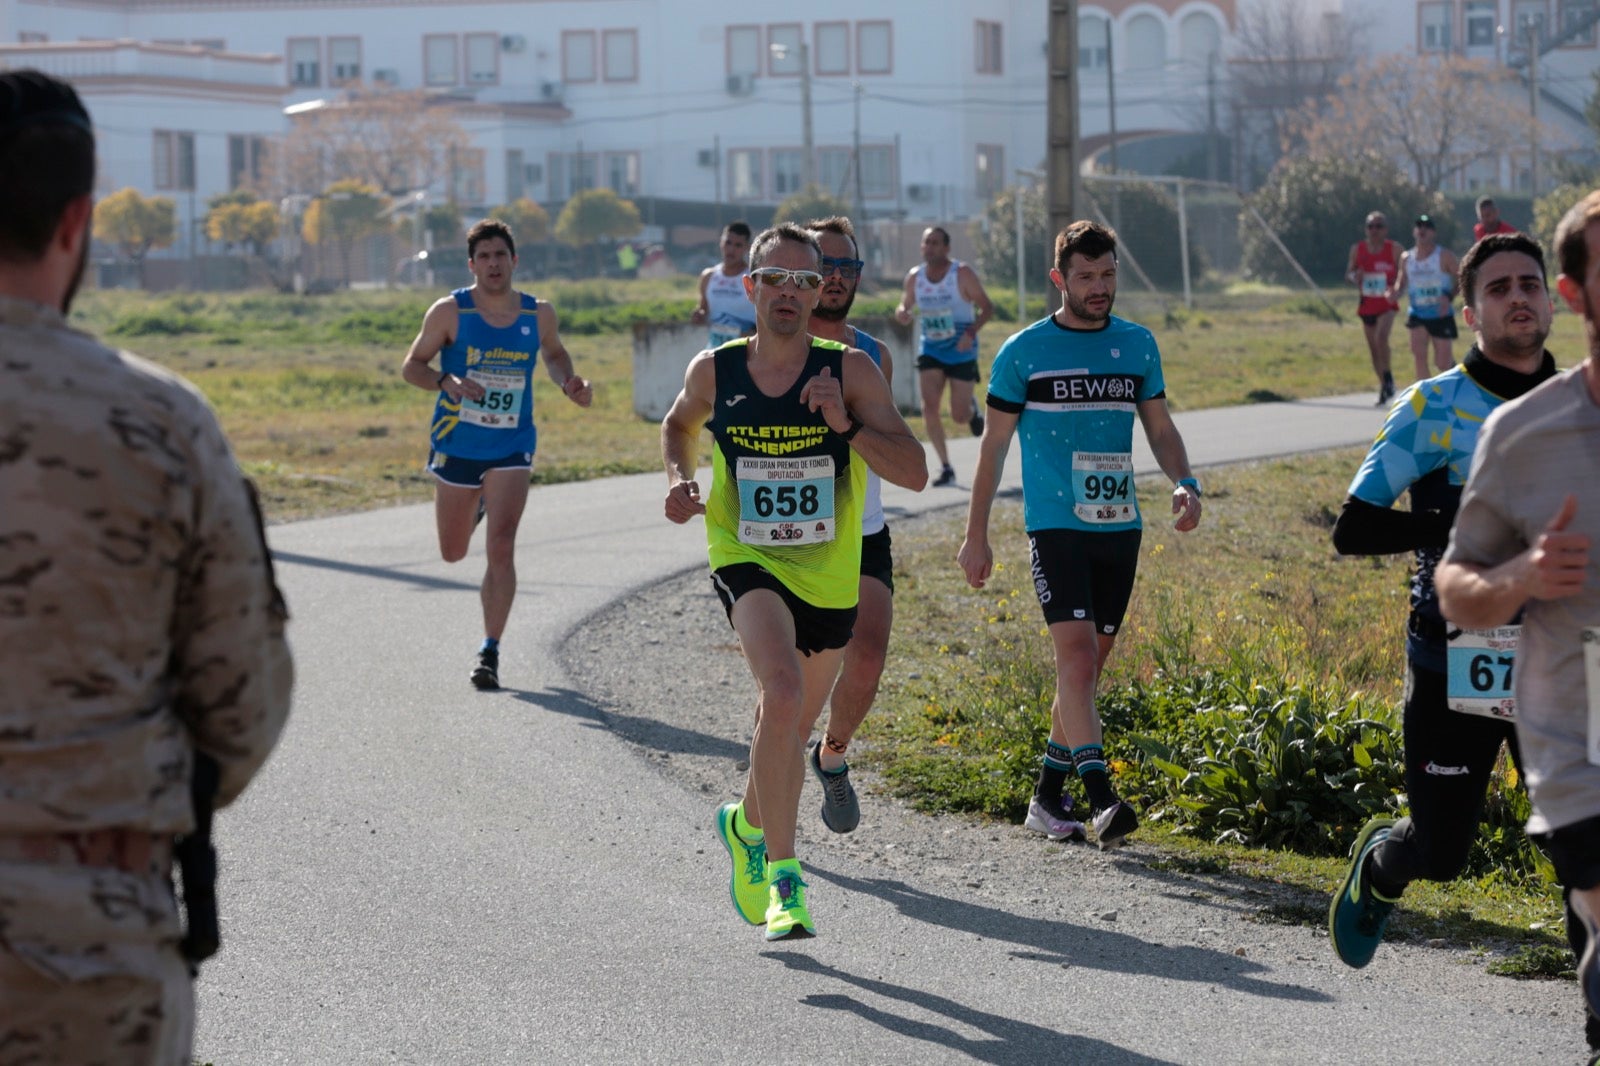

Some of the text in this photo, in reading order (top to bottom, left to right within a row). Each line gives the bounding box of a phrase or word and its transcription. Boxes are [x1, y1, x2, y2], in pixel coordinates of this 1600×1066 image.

[485, 348, 529, 362] olimpo
[726, 425, 830, 439] ATLETISMO
[732, 435, 824, 457] ALHENDÍN
[760, 460, 776, 470] GRAN
[777, 460, 800, 470] PREMIO
[801, 460, 809, 469] DE
[809, 458, 830, 468] FONDO
[767, 470, 805, 480] DIPUTACIÓN
[1085, 475, 1129, 500] 994
[754, 484, 819, 518] 658
[1470, 654, 1515, 692] 67
